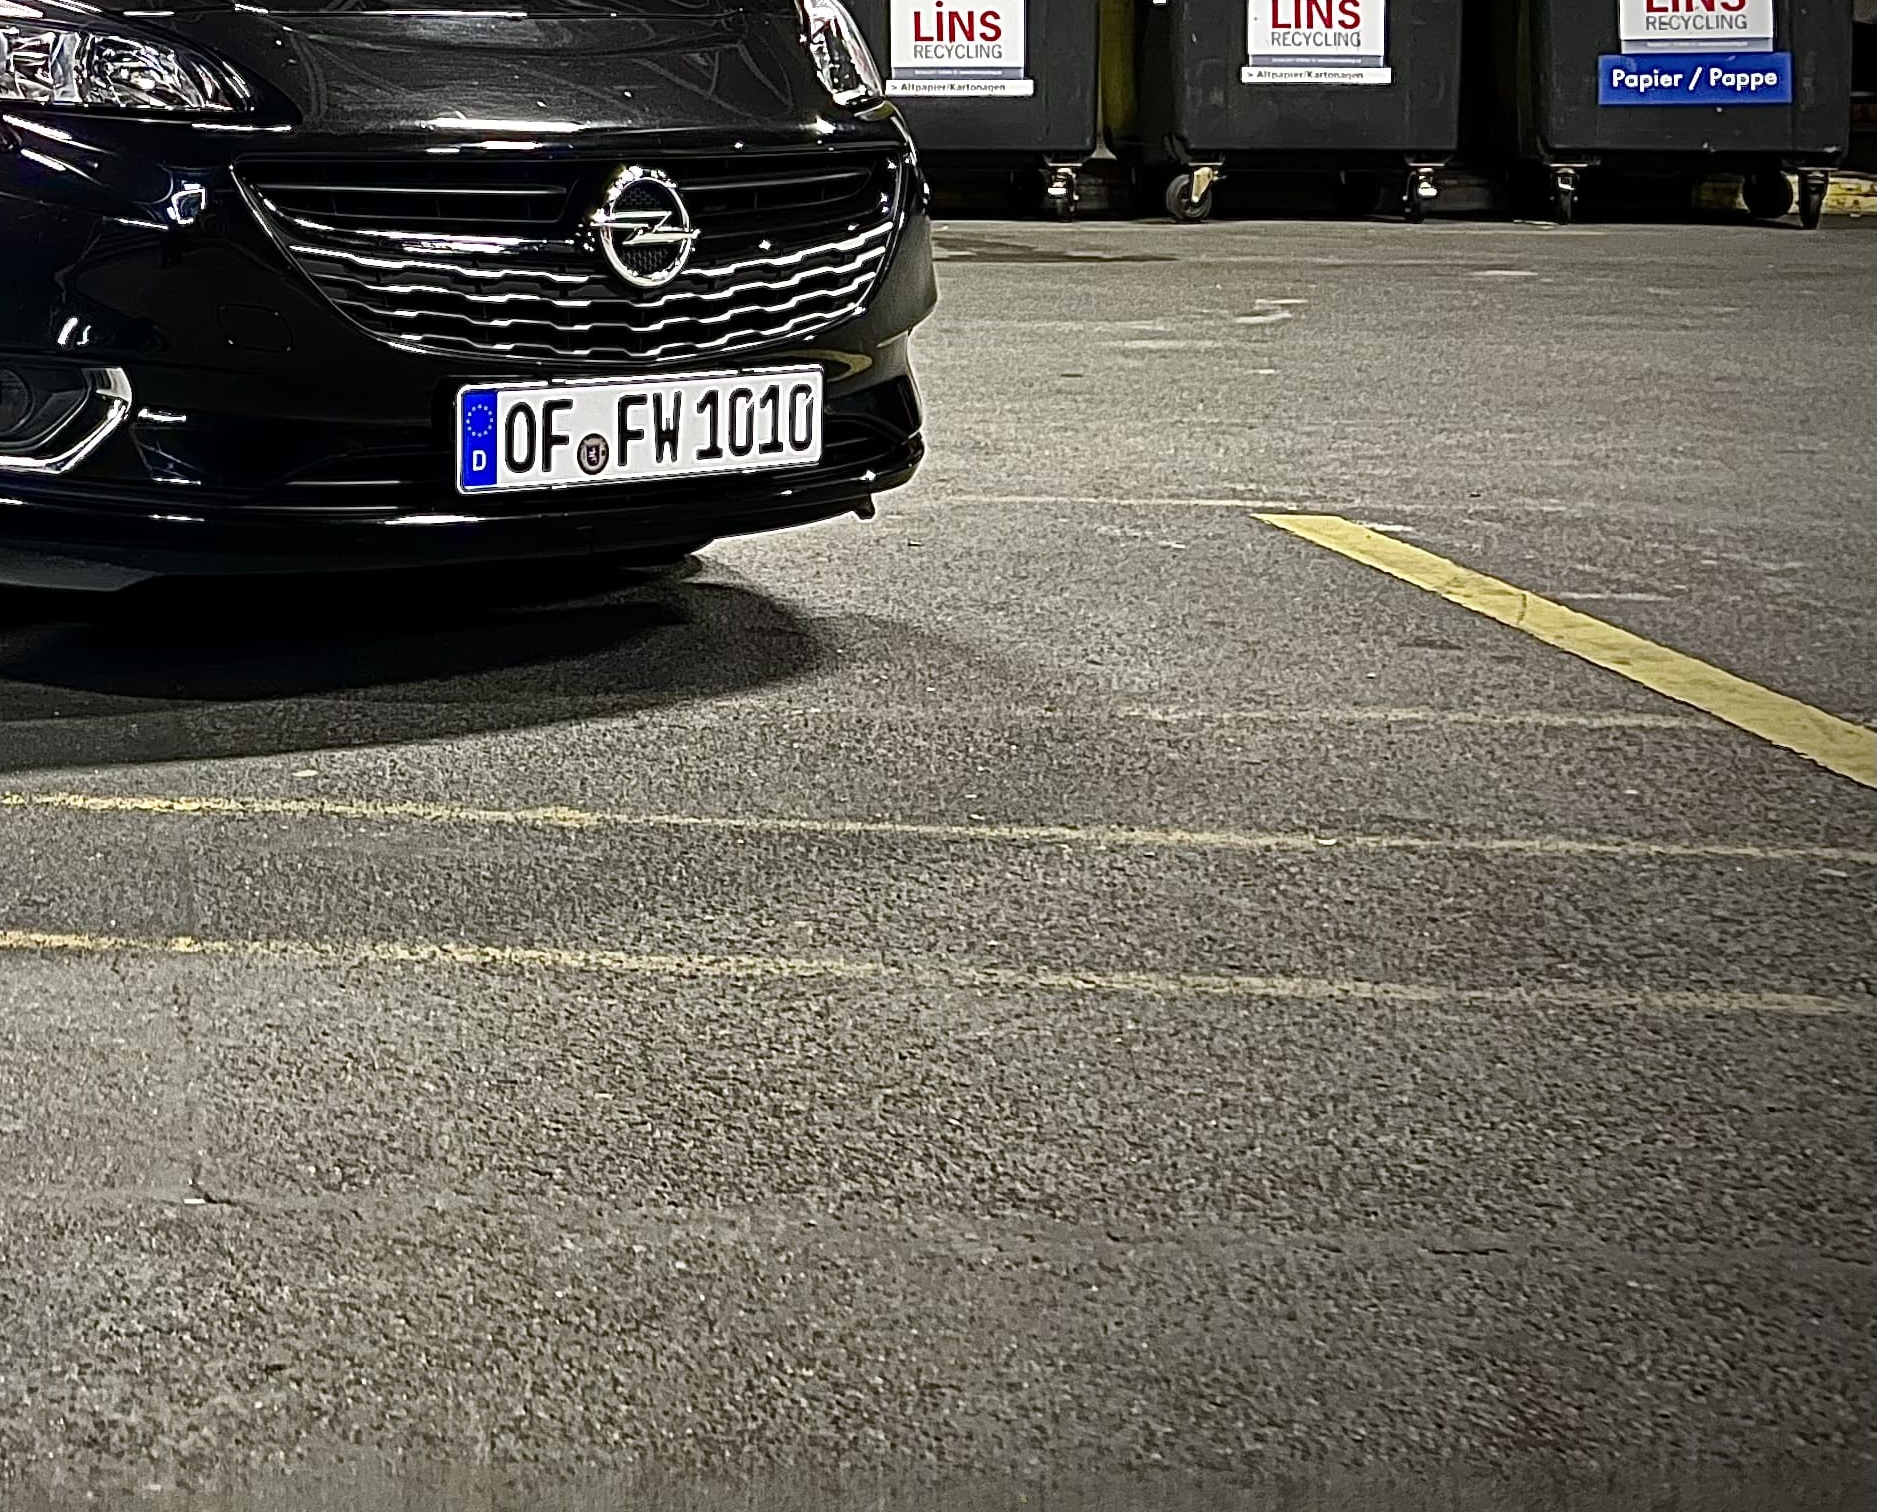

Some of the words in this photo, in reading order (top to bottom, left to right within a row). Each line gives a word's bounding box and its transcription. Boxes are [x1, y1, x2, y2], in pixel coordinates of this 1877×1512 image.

[1645, 14, 1748, 31] RECYCLING
[1271, 31, 1361, 47] RECYCLING
[913, 43, 1003, 59] RECYCLING
[1612, 68, 1683, 93] Papier
[1688, 67, 1702, 91] /
[1709, 68, 1778, 91] Pappe
[472, 449, 487, 472] D
[504, 399, 573, 473] OF
[618, 391, 681, 466] FW
[696, 384, 814, 460] 1010
